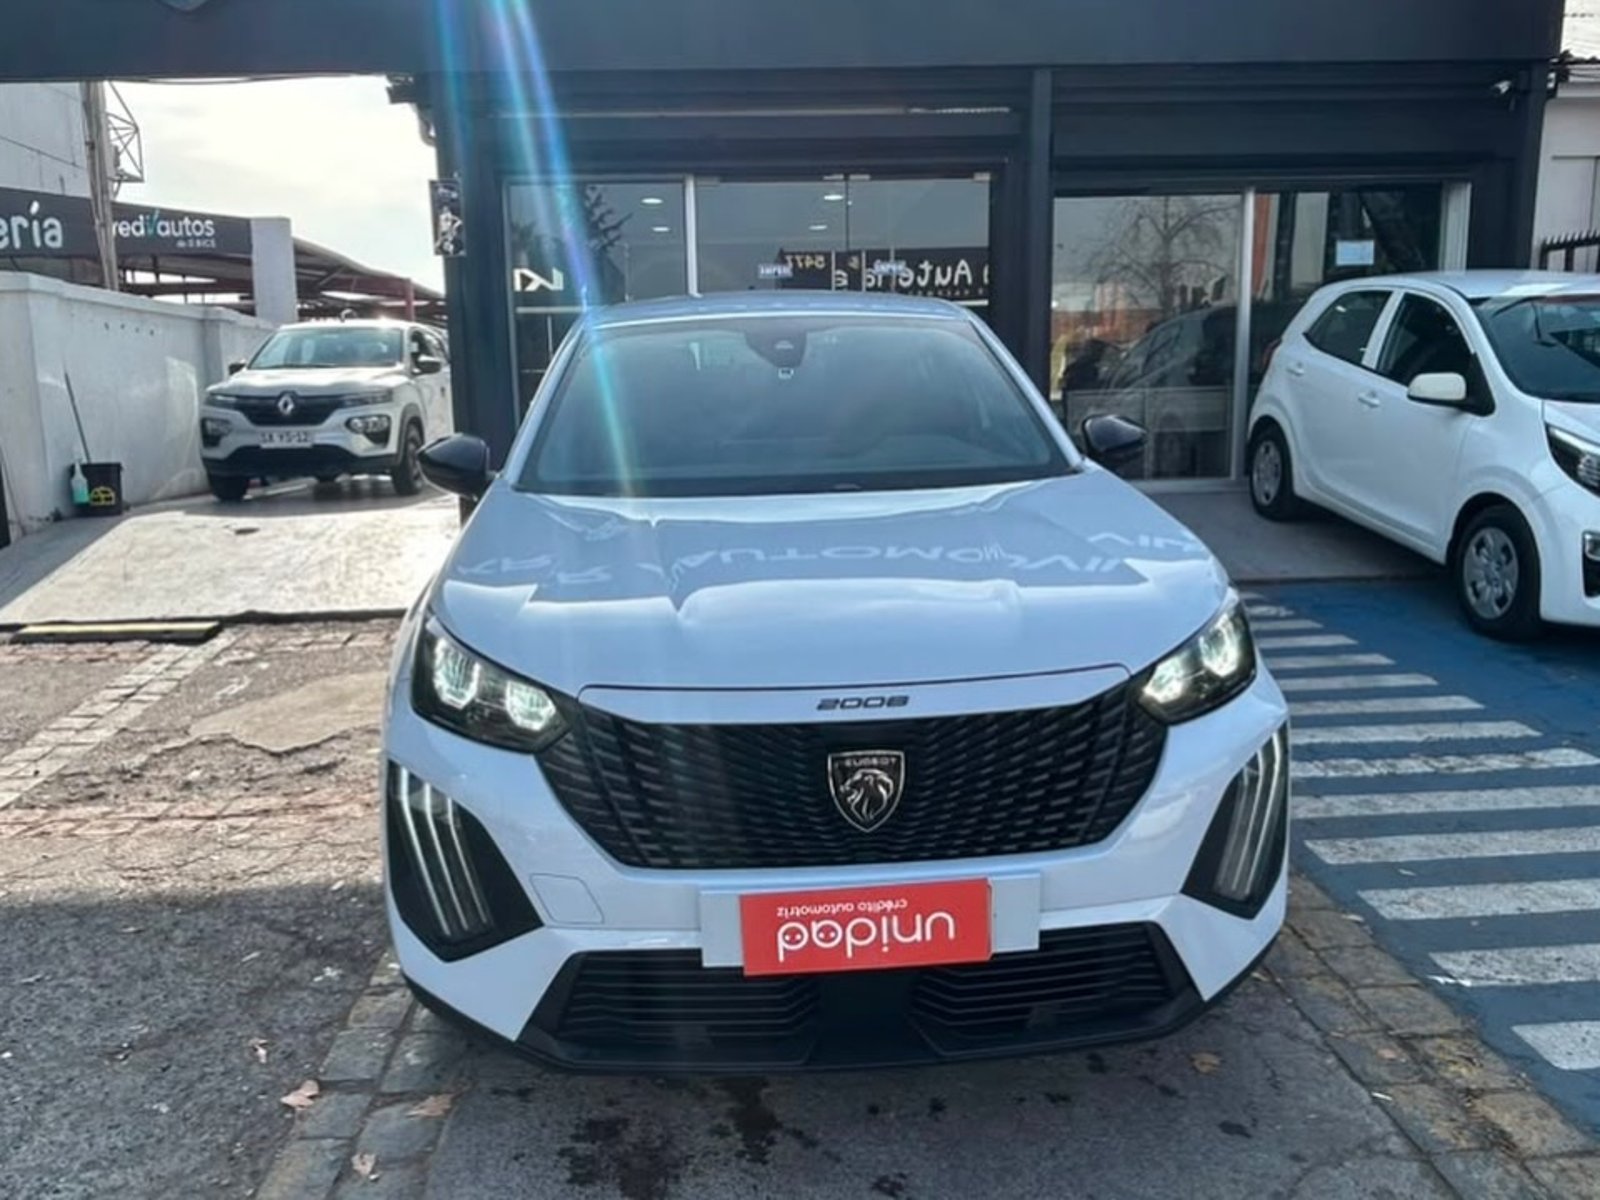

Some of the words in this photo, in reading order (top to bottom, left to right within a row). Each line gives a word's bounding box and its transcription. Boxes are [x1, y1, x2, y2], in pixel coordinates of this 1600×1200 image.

[816, 695, 910, 711] 2008
[776, 902, 855, 918] automotriz
[777, 911, 955, 962] unidad
